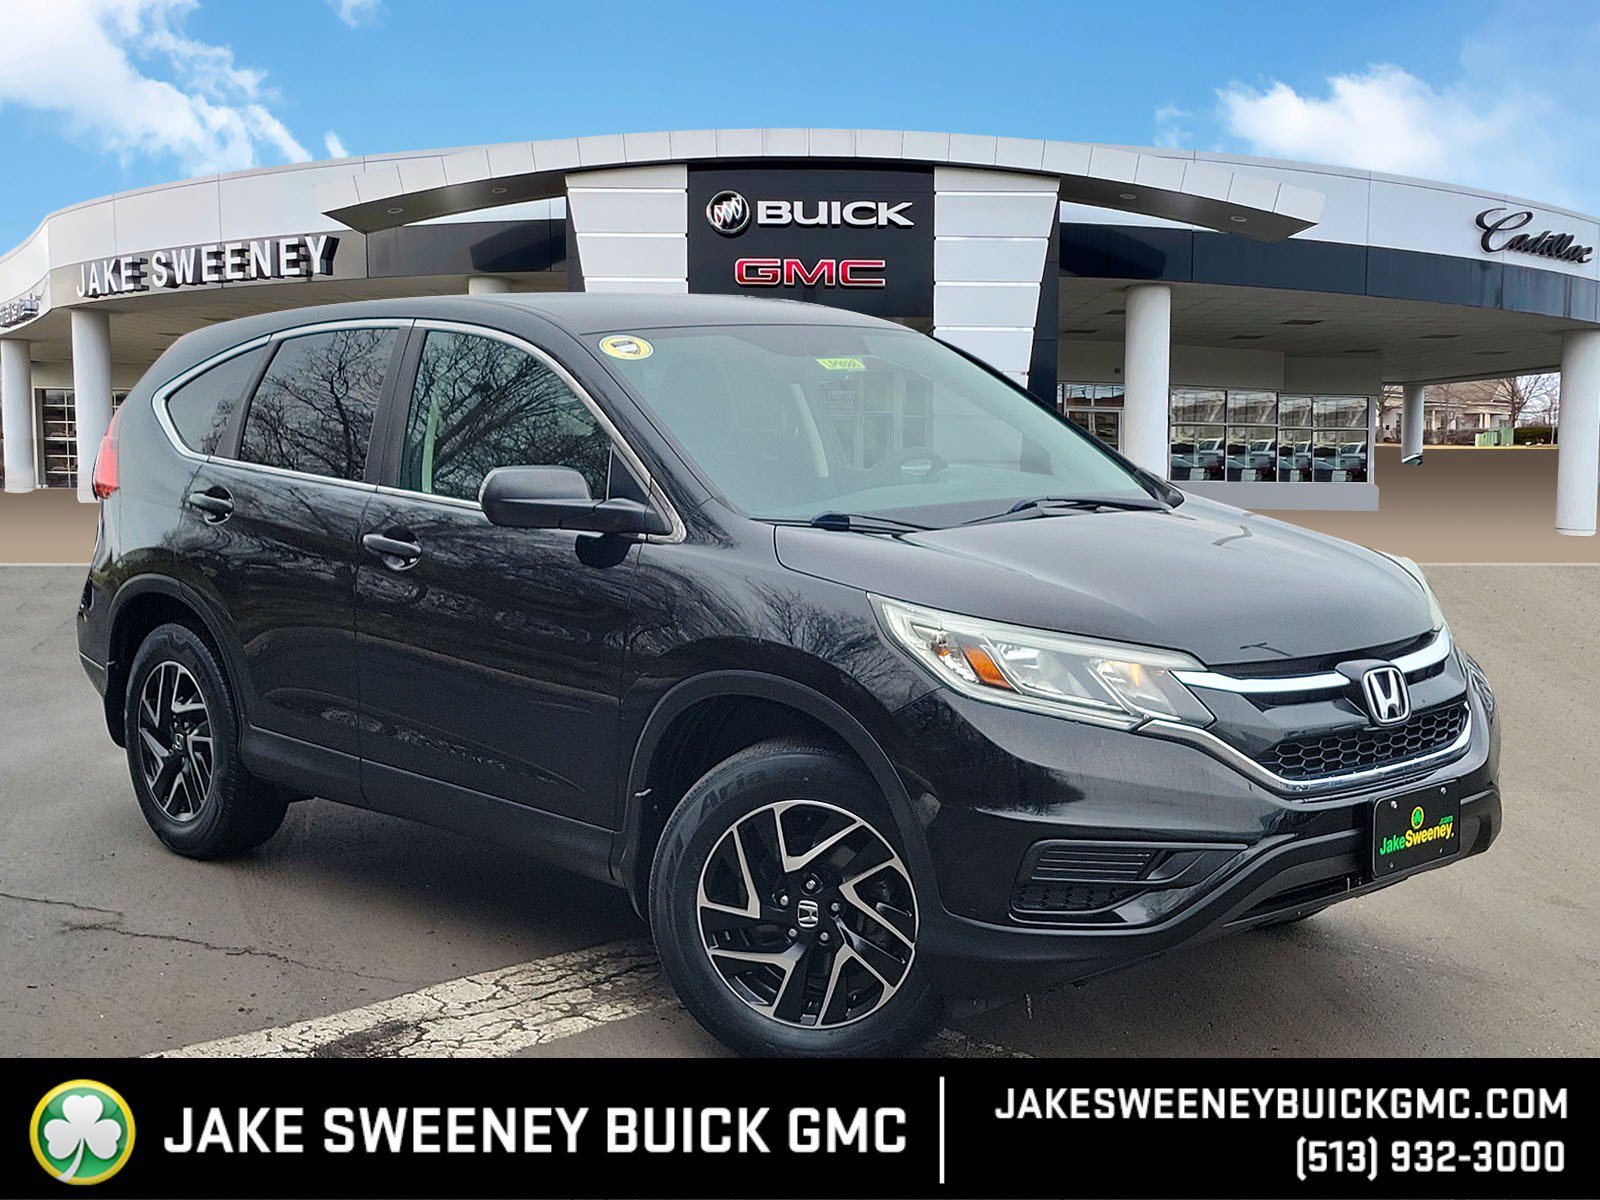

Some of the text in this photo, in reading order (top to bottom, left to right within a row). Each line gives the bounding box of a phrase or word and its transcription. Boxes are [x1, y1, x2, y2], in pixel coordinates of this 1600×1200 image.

[756, 200, 915, 227] BUICK
[1475, 207, 1593, 264] Cadillac
[76, 234, 332, 298] JAKE SWEENEY
[734, 257, 886, 288] GMC
